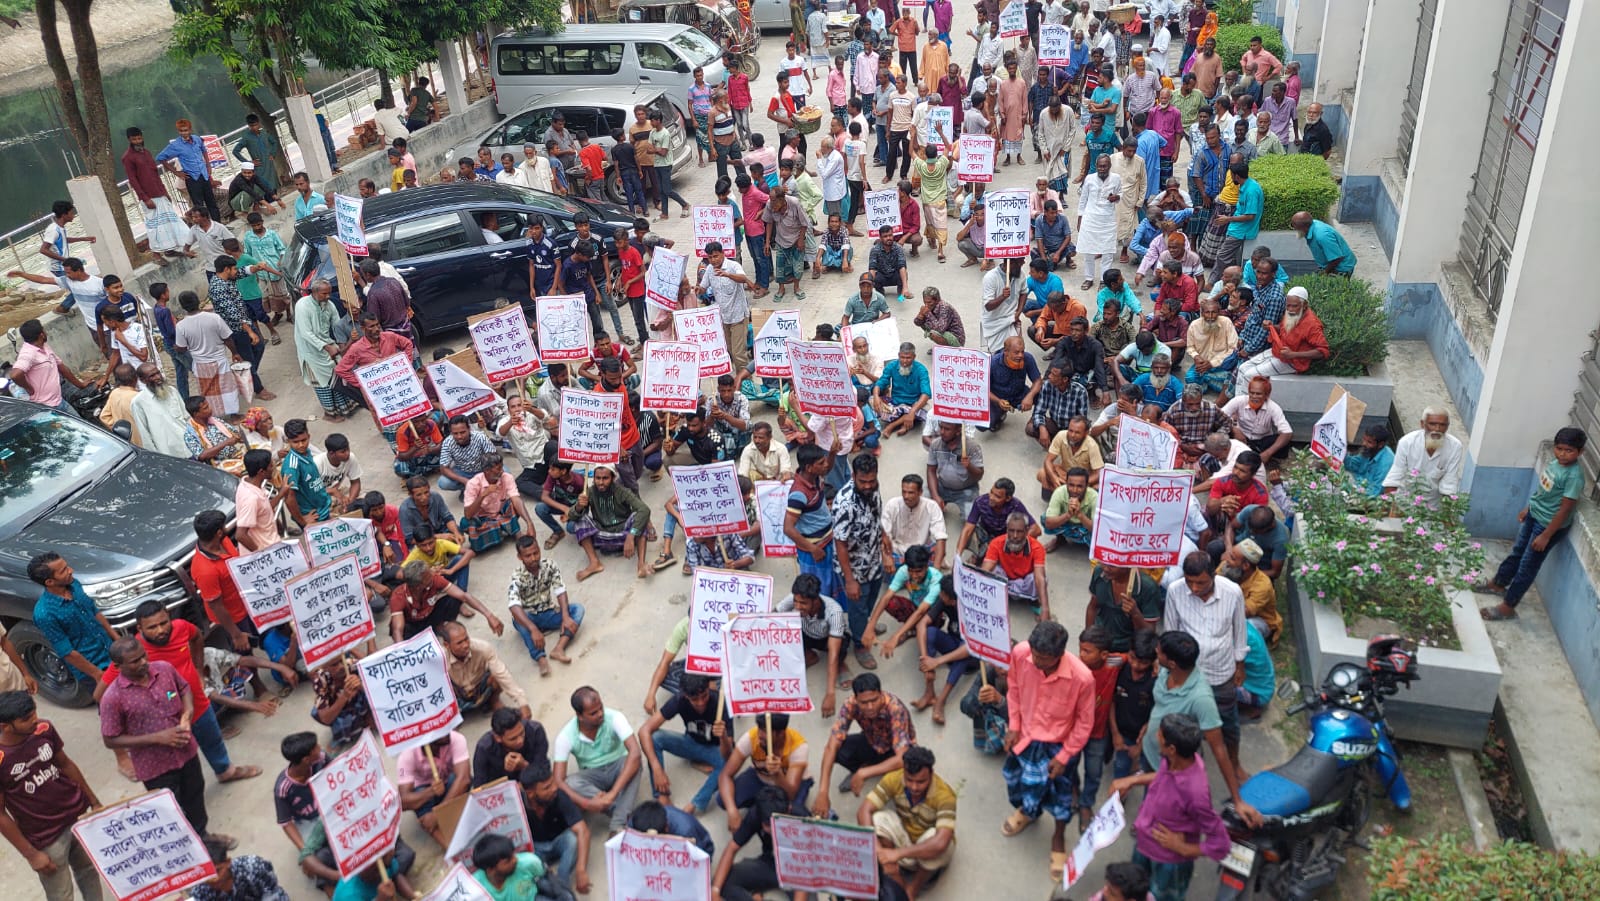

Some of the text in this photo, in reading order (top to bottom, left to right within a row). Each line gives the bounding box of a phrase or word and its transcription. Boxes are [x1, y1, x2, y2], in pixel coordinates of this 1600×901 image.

[572, 429, 609, 441] কেন হবে
[675, 469, 731, 485] মধ্যবর্তী স্থান
[685, 487, 708, 498] থেকে
[716, 498, 735, 508] কেন
[1110, 480, 1184, 504] সংখ্যাগরিষ্ঠের
[1131, 507, 1154, 528] দাবি
[1109, 529, 1171, 550] মানতে হবে
[699, 576, 766, 600] মধ্যবর্তী স্থান
[704, 600, 732, 614] থেকে
[306, 609, 363, 645] দিতে হবে
[730, 622, 801, 648] সংখ্যাগরিষ্ঠের
[365, 642, 438, 681] ফ্যাসিস্টদের
[757, 649, 781, 673] দাবি
[386, 672, 429, 700] সিদ্ধান্ত
[742, 678, 801, 696] মানতে হবে
[385, 686, 446, 725] বাতিল কর
[326, 770, 346, 791] ৪০
[102, 808, 161, 841] ভূমি অফিস
[99, 821, 181, 859] সরানো চলবে না
[645, 871, 672, 894] দাবি
